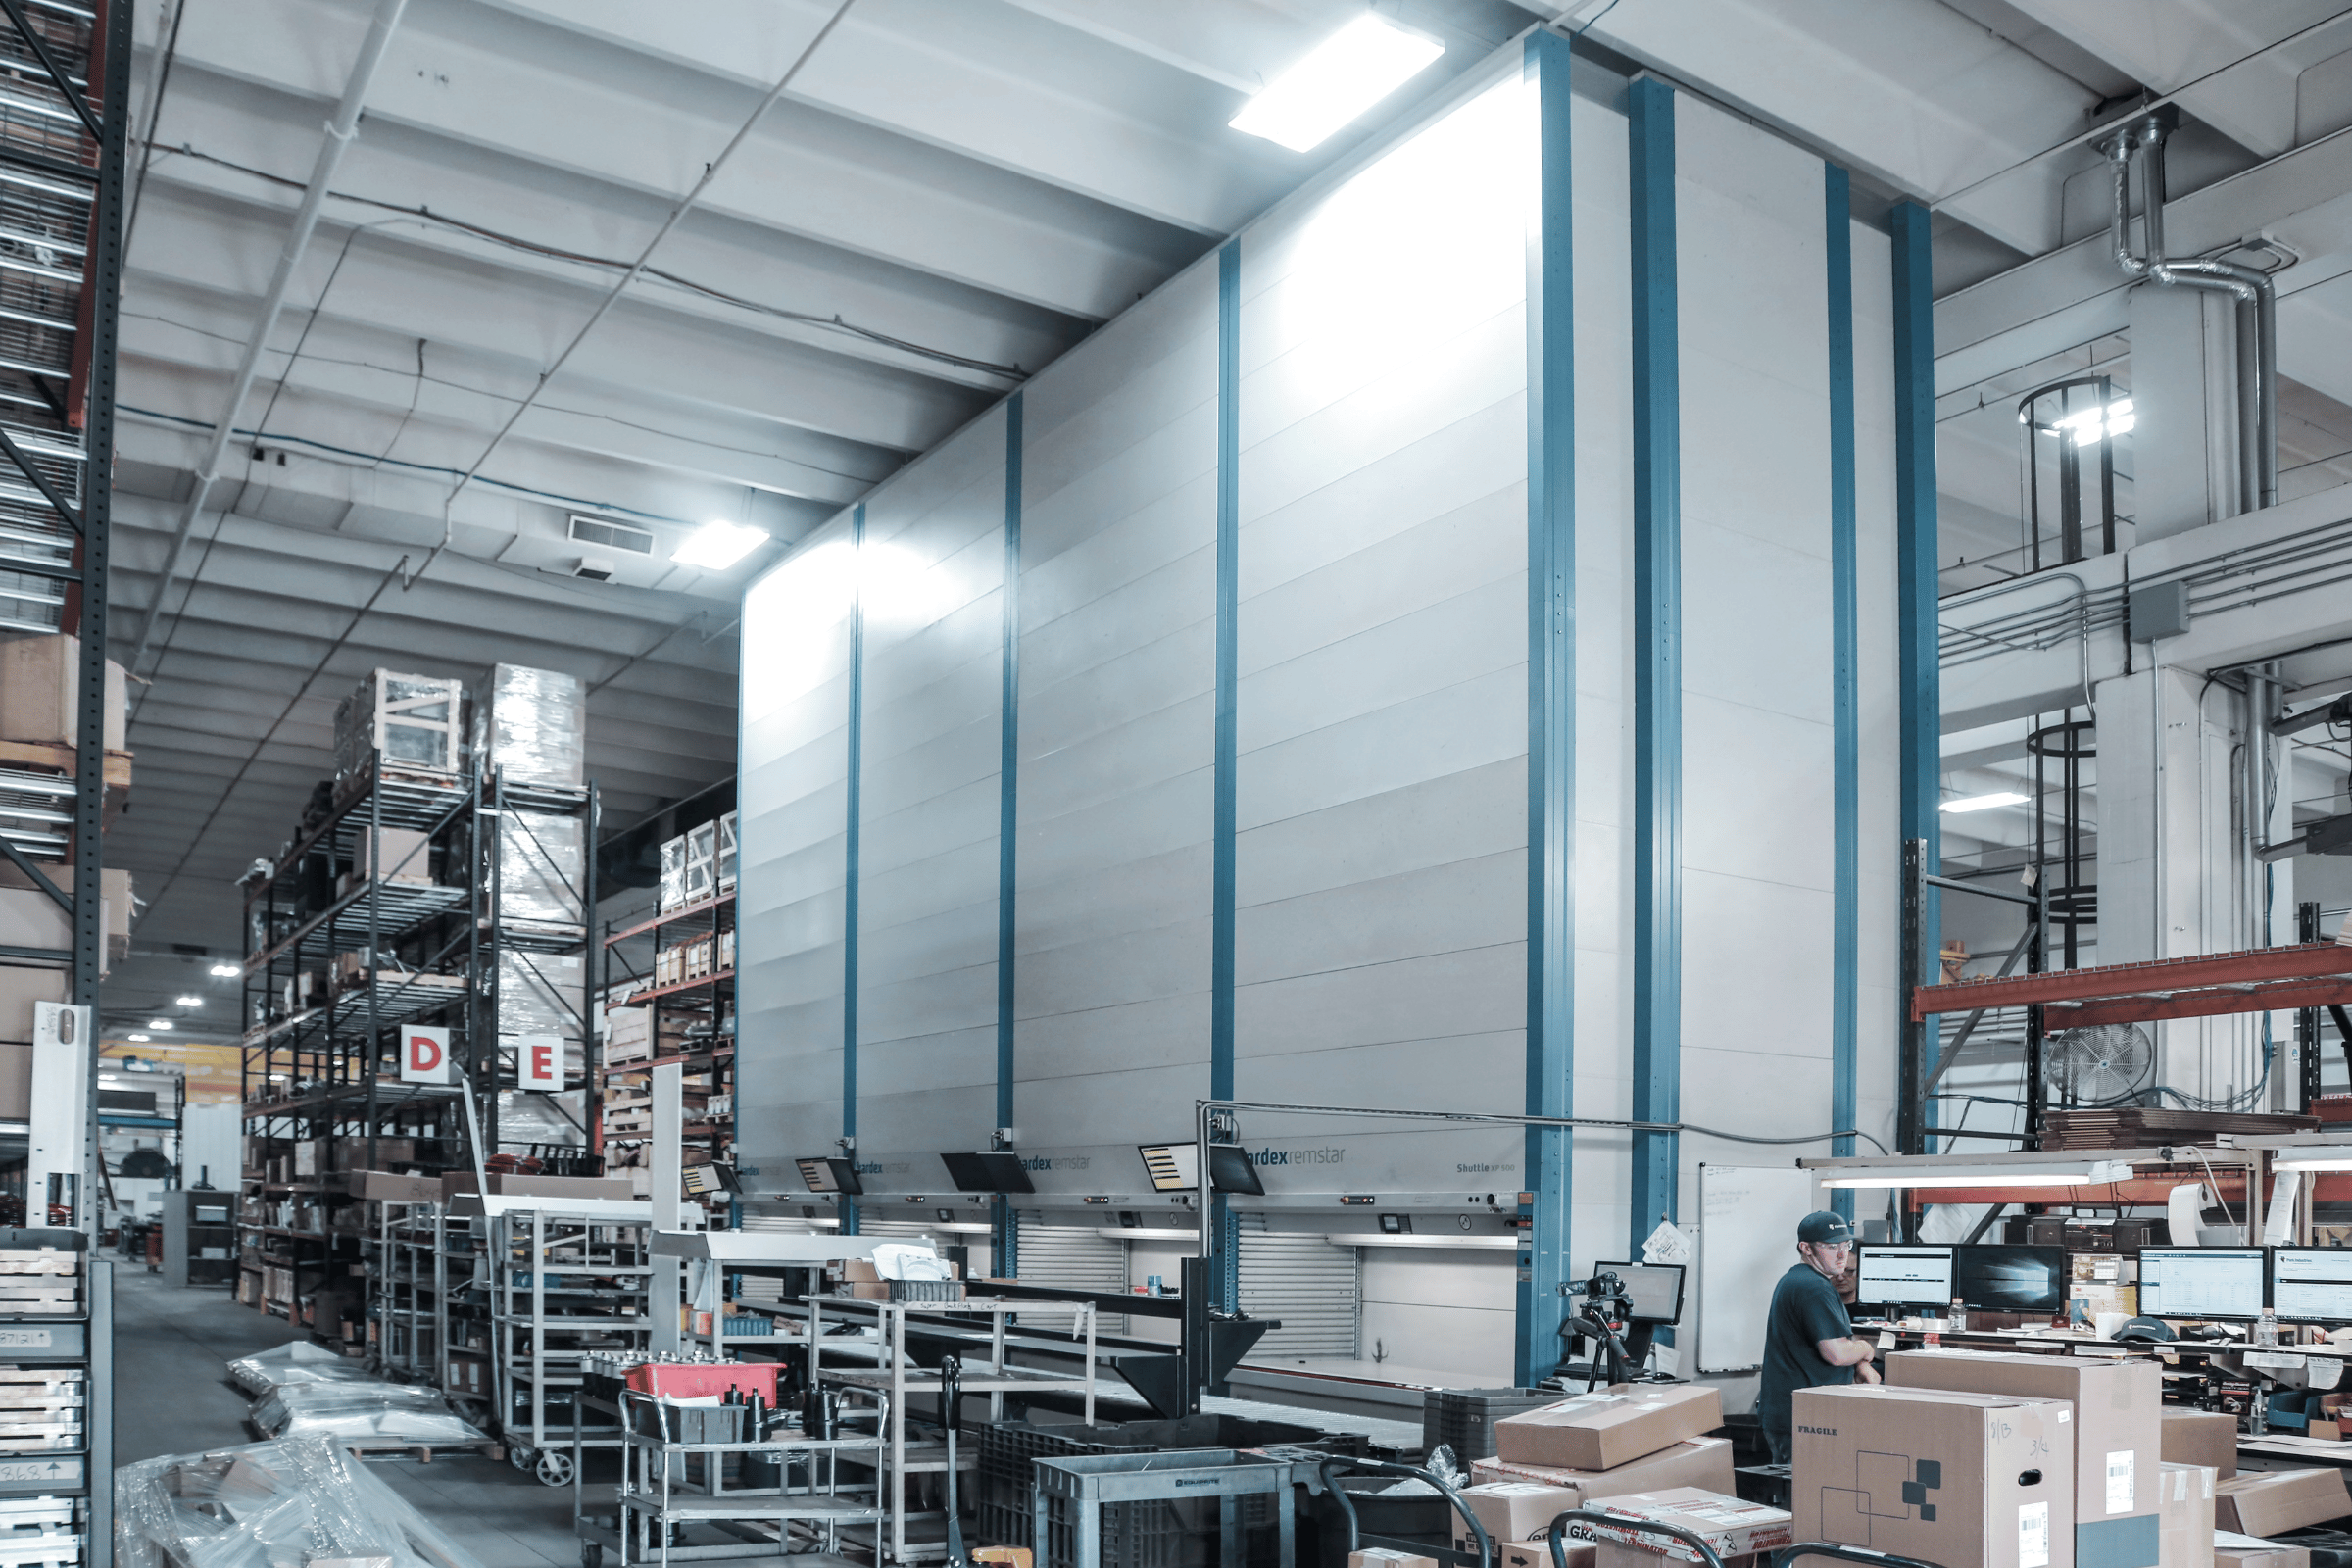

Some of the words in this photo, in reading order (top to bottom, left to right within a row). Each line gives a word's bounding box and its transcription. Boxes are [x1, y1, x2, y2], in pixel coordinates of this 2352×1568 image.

[410, 1036, 442, 1071] D
[531, 1045, 553, 1080] E
[1456, 1163, 1490, 1173] Shuttle
[1797, 1425, 1838, 1437] FRAGILE
